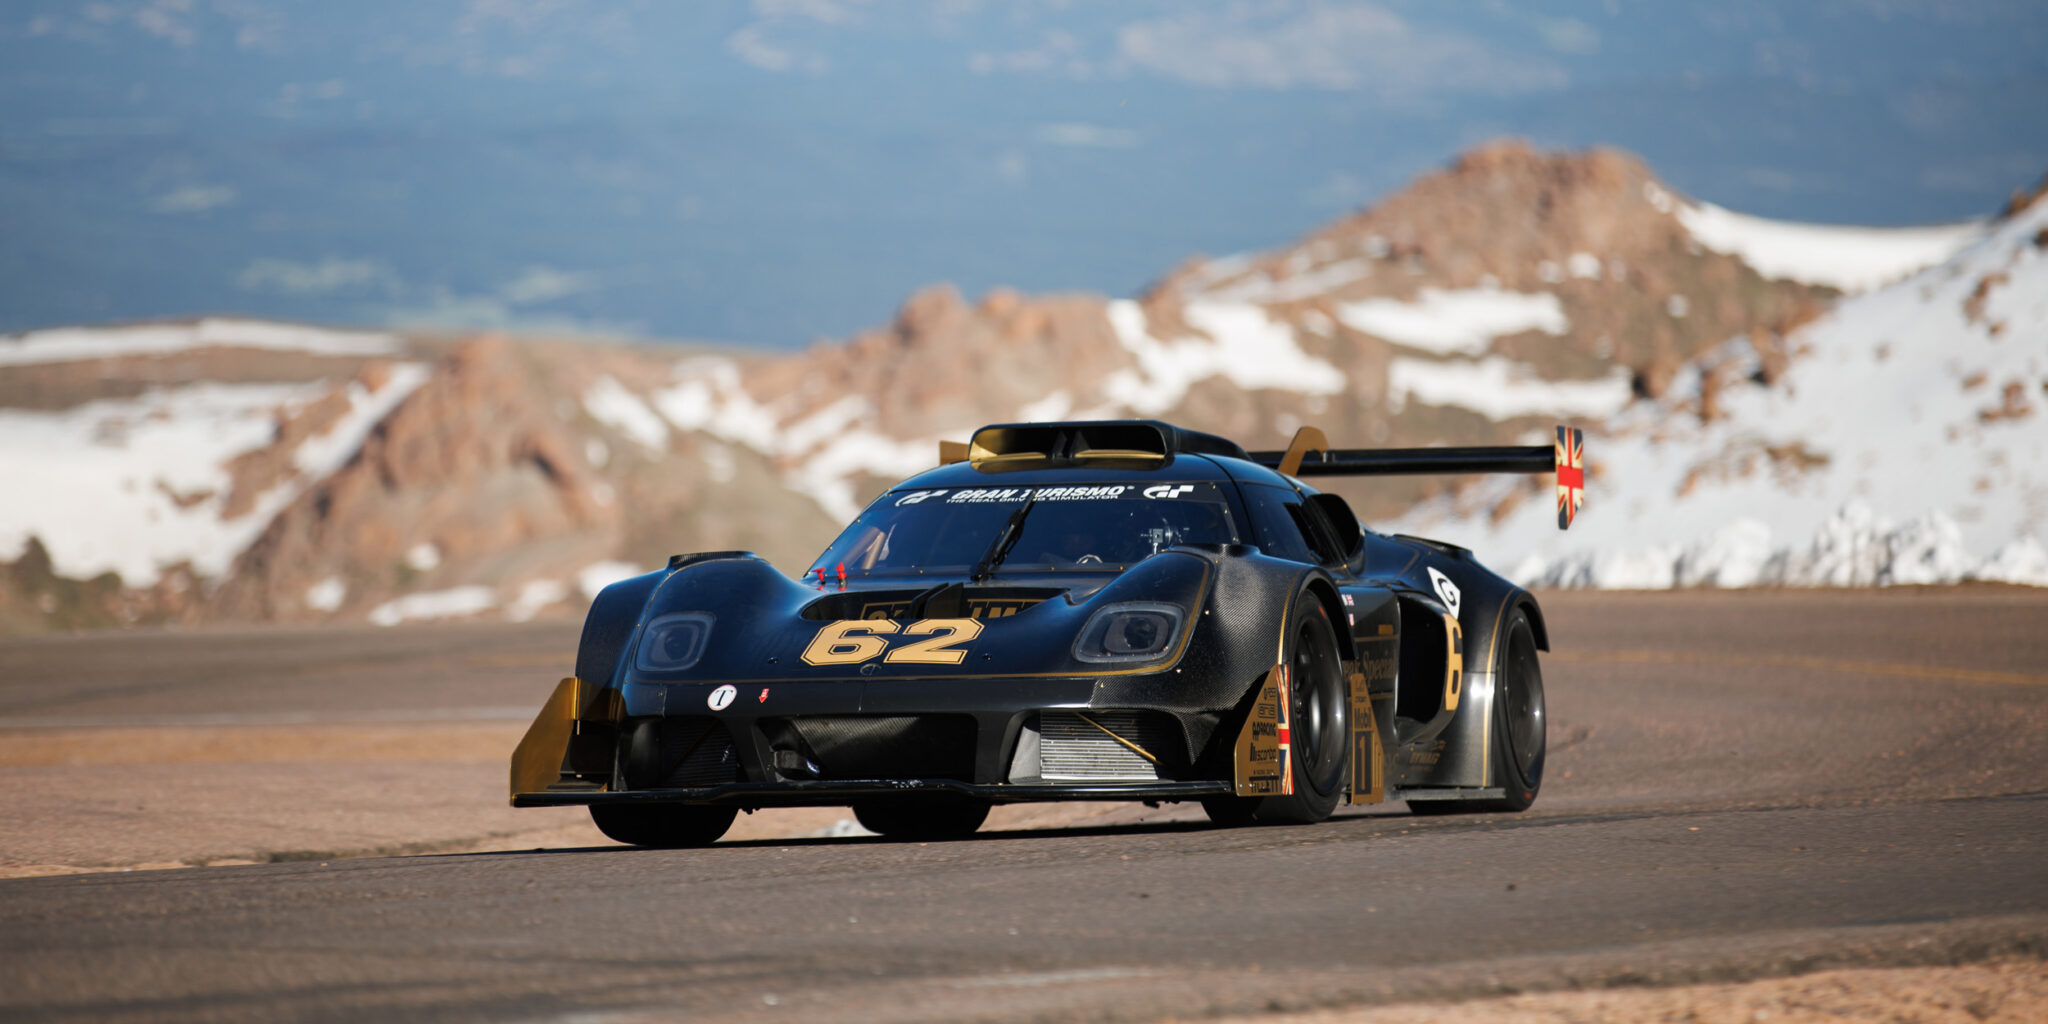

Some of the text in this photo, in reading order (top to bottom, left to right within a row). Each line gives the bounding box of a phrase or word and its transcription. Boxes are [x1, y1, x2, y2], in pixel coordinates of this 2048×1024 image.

[951, 489, 1019, 499] GRAN
[800, 617, 985, 666] 62
[715, 689, 734, 706] T
